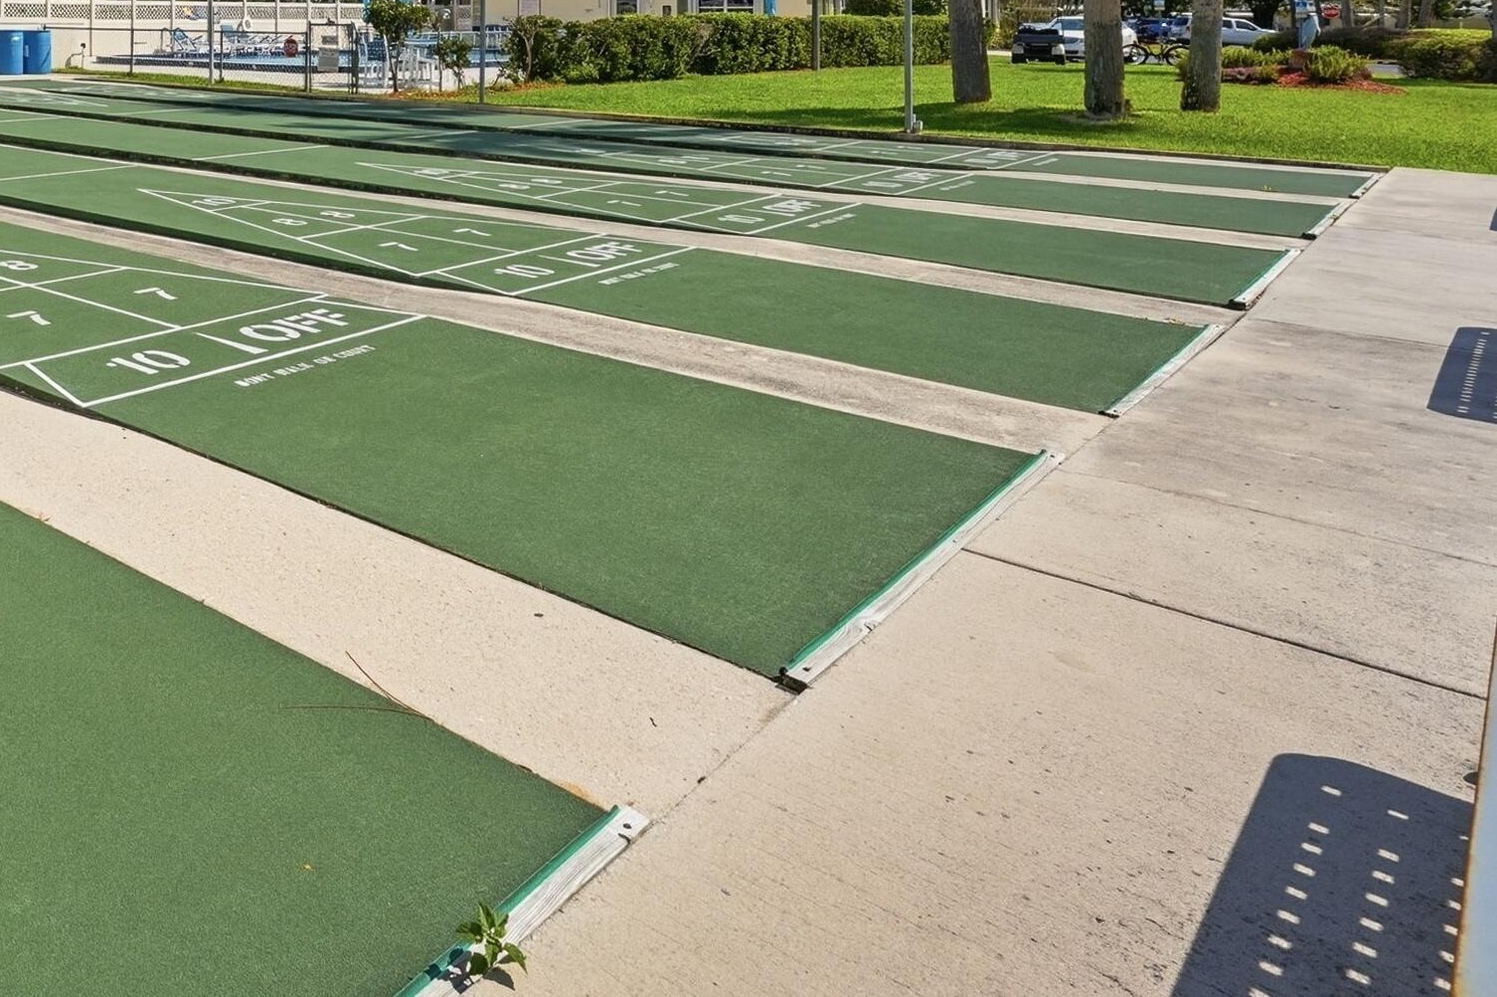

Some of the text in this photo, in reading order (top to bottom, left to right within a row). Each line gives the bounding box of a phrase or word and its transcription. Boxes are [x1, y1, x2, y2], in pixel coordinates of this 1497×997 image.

[494, 264, 555, 279] 10
[133, 286, 178, 301] 7
[6, 310, 51, 326] 7
[106, 308, 349, 376] 10 OFF
